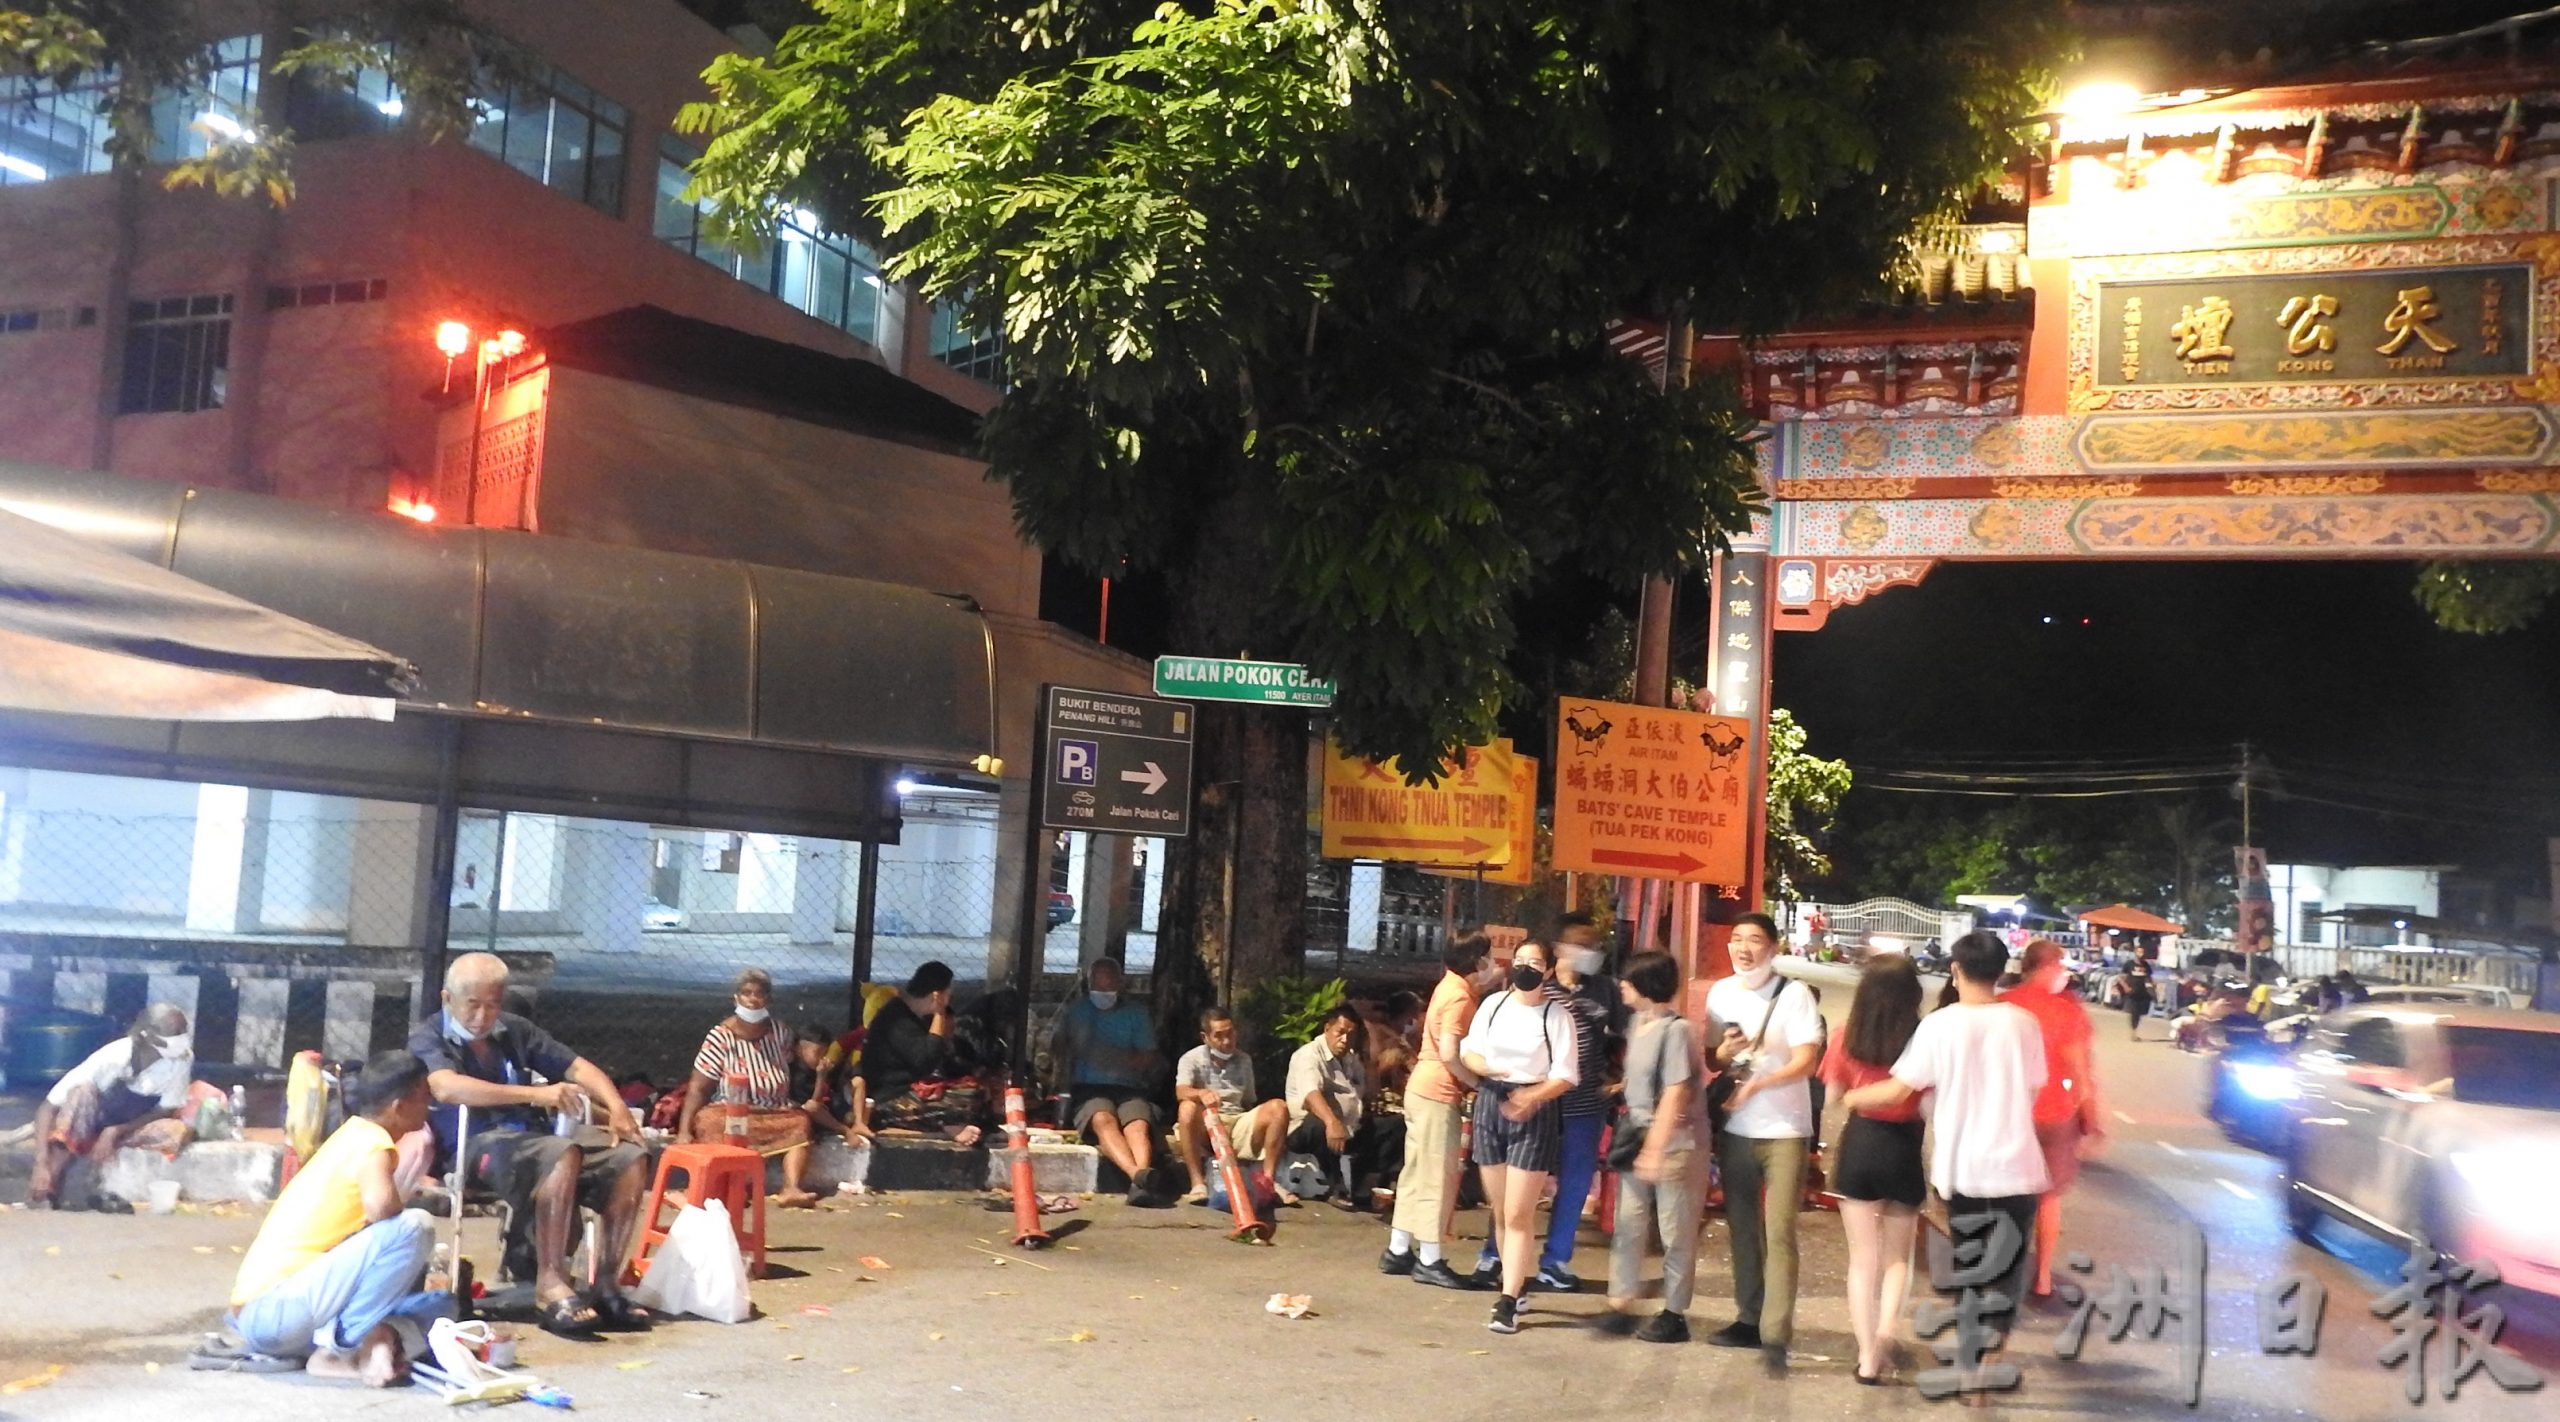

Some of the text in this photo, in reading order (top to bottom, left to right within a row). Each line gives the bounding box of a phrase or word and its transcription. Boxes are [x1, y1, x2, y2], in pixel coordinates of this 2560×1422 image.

[2183, 355, 2445, 376] TIEN KONG THAN
[1164, 662, 1220, 683] JALAN
[1223, 665, 1285, 687] POKOK
[1264, 690, 1287, 700] 11500
[1291, 691, 1312, 701] AYER
[1059, 697, 1142, 716] BUKIT BENDERA
[1058, 710, 1096, 723] PENANG
[1097, 715, 1117, 725] HILL
[1628, 746, 1679, 762] AIR ITAM
[1566, 760, 1740, 807] 蝙蝠洞大伯公廟
[1066, 806, 1095, 818] 270M
[1109, 805, 1180, 821] Jalan Pokok Ceri
[1367, 788, 1408, 824] KONG
[1413, 791, 1449, 827] TNUA
[1453, 793, 1508, 829] TEMPLE
[1577, 799, 1727, 828] BATS' CAVE TEMPLE
[1589, 820, 1713, 849] (TUA PEK KONG)
